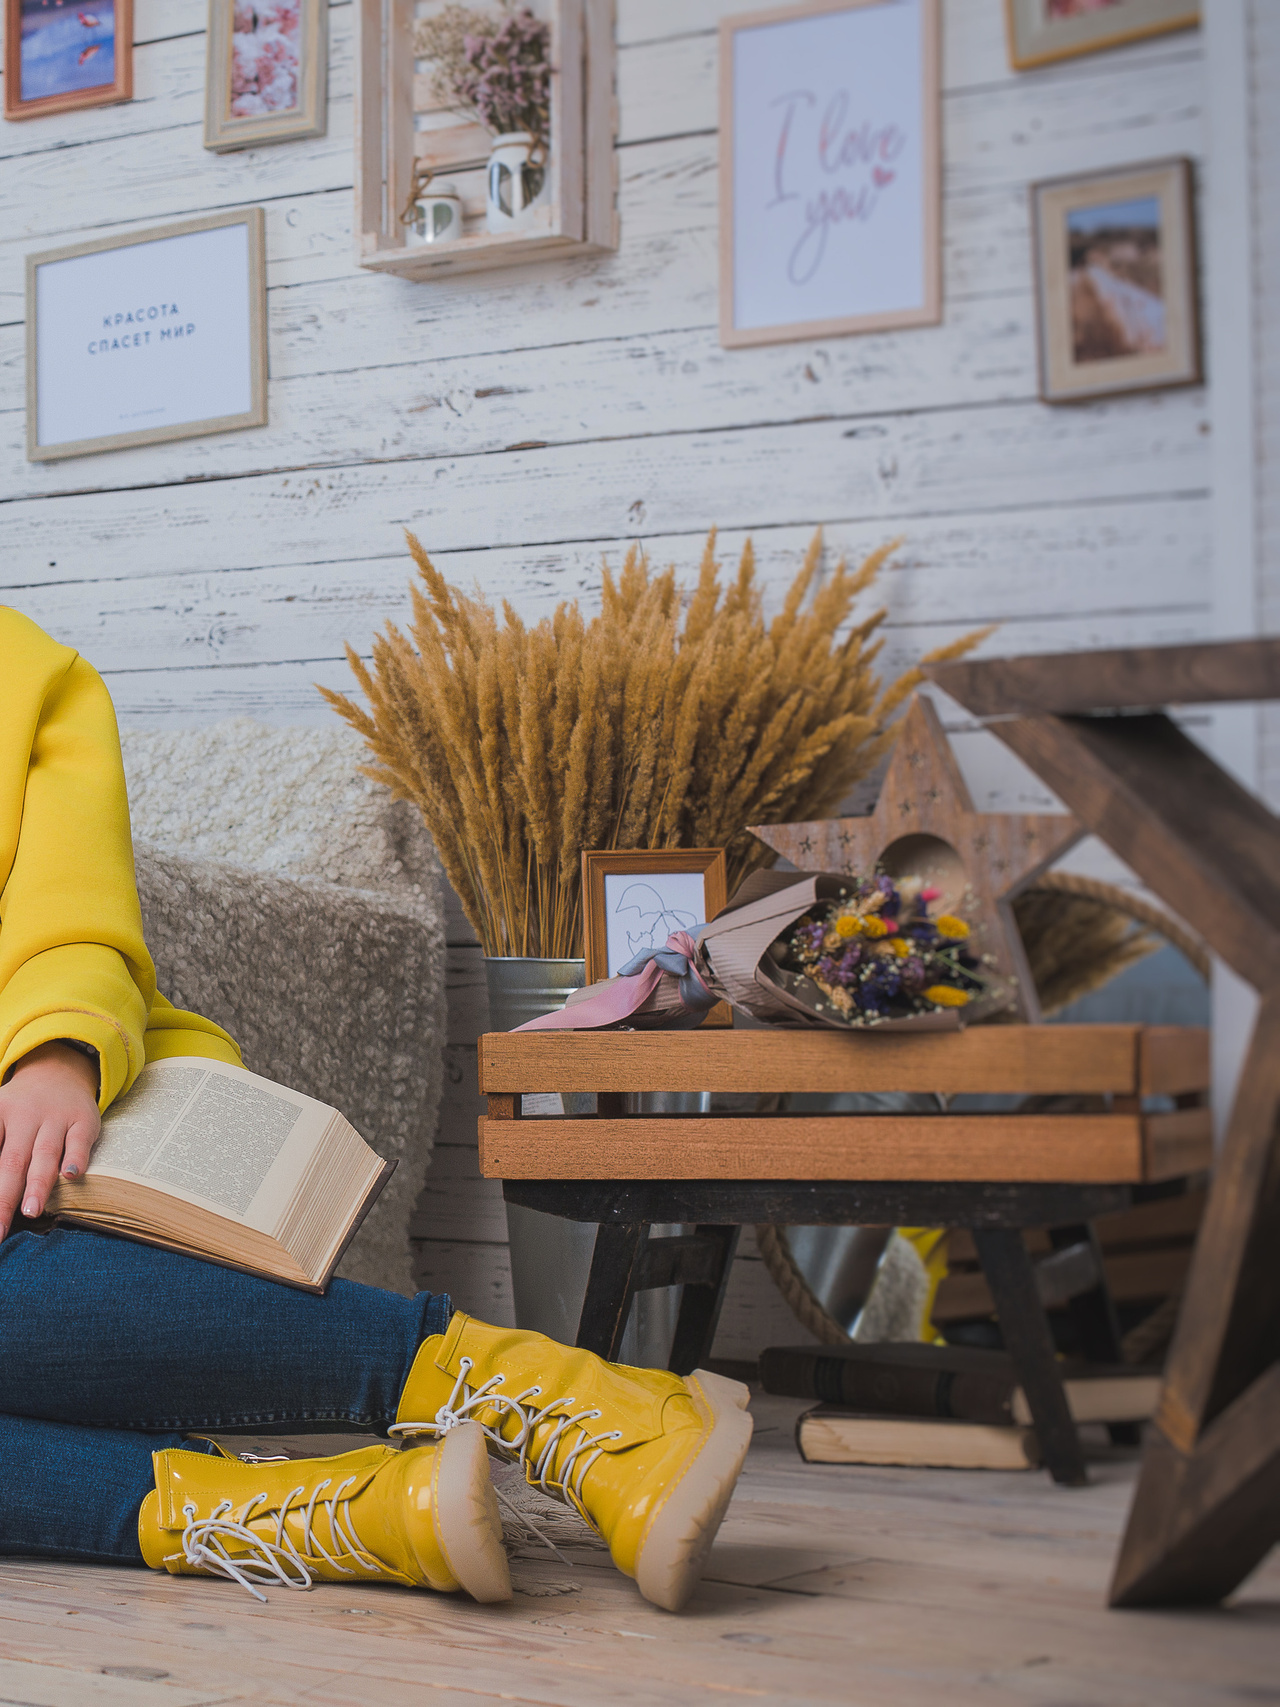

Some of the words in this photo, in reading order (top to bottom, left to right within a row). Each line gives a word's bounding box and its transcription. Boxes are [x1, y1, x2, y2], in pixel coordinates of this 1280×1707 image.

[766, 90, 815, 208] I
[819, 89, 905, 173] love
[788, 187, 877, 285] you
[87, 331, 151, 355] СПАСЕТ
[160, 323, 196, 341] МИР
[103, 303, 179, 327] КРАСОТА
